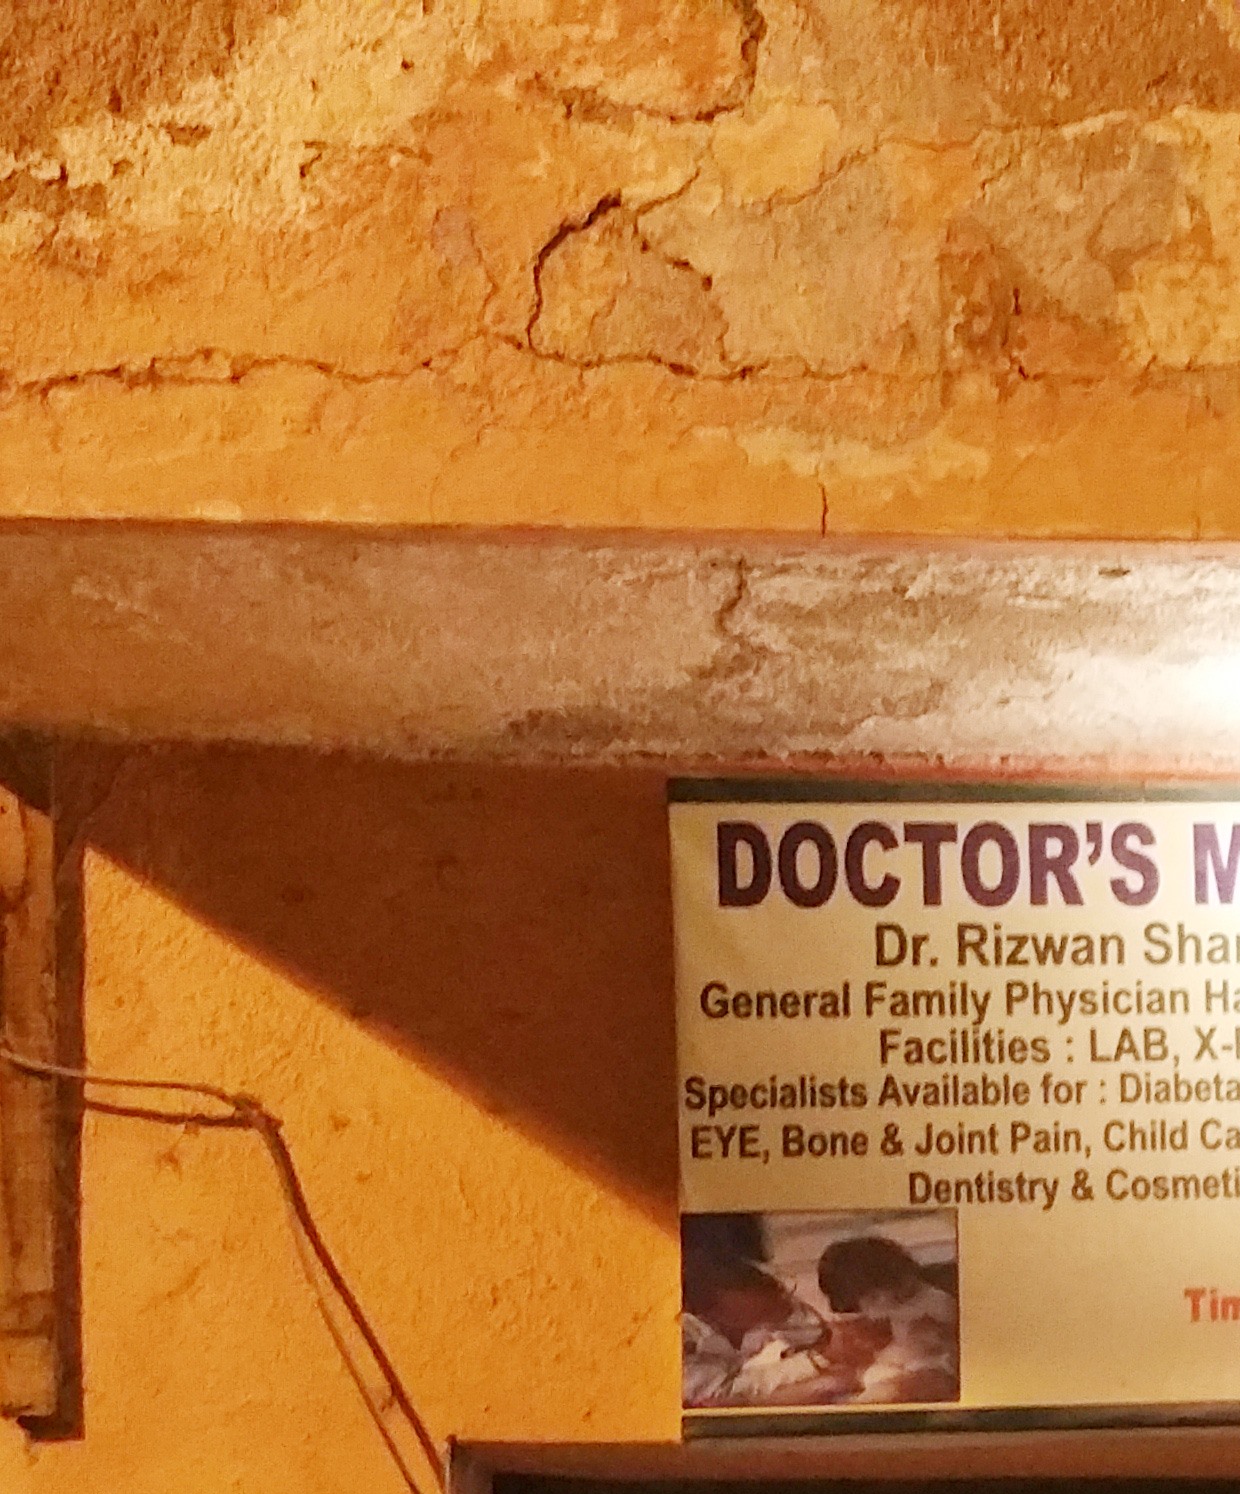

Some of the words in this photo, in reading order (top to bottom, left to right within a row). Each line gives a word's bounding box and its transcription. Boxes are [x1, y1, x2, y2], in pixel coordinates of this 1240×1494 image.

[715, 818, 1161, 909] DOCTOR'S
[874, 922, 939, 968] Dr.
[956, 921, 1126, 967] Rizwan
[699, 980, 851, 1020] General
[864, 978, 992, 1026] Family
[1005, 978, 1191, 1026] Physician
[878, 1028, 1052, 1065] Facilities
[1088, 1026, 1181, 1069] LAB,
[684, 1075, 868, 1113] Specialists
[878, 1073, 1031, 1107] Available
[1040, 1073, 1088, 1106] for
[690, 1124, 771, 1164] EYE,
[782, 1124, 869, 1157] Bone
[879, 1123, 904, 1157] &
[914, 1122, 999, 1157] Joint
[1010, 1121, 1093, 1160] Pain,
[1103, 1119, 1189, 1153] Child
[908, 1170, 1060, 1211] Dentistry
[1071, 1170, 1096, 1202] &
